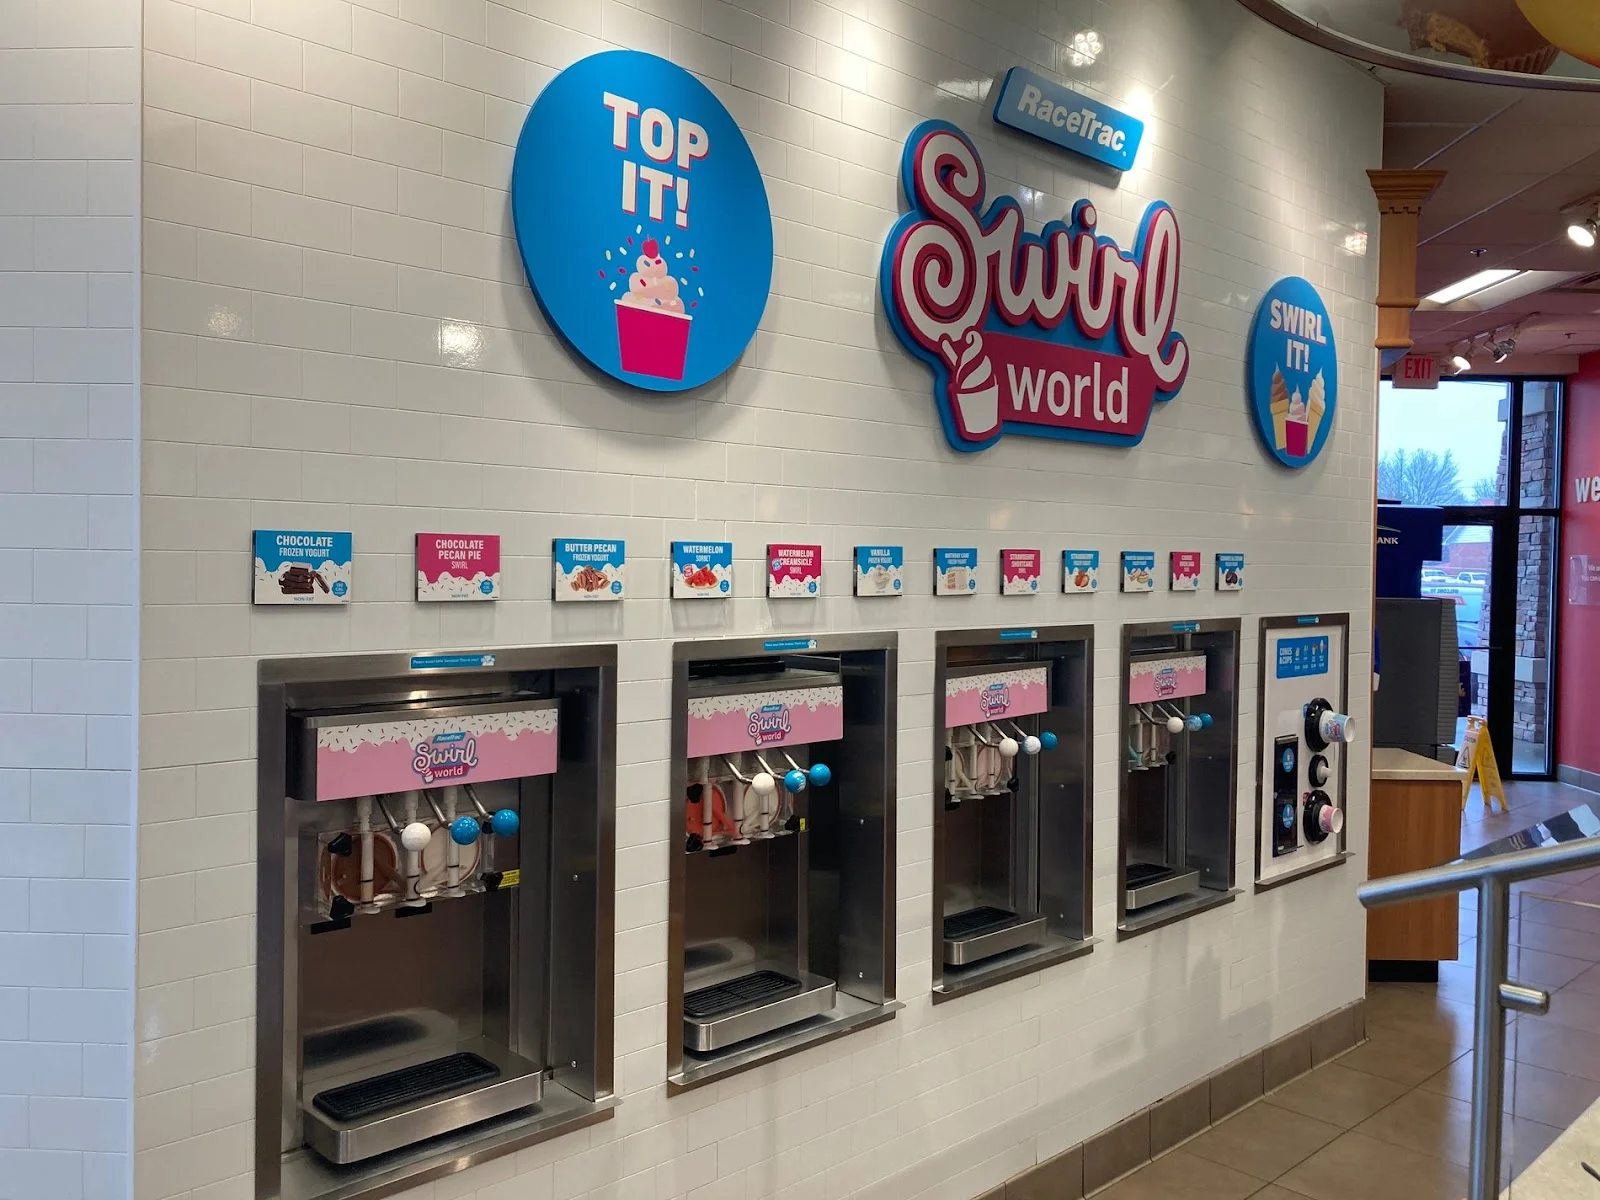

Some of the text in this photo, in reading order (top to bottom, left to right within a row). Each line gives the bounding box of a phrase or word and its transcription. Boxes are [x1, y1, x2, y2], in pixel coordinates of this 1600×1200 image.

[1017, 83, 1126, 152] RaceTrac
[603, 91, 710, 171] TOP
[621, 159, 690, 230] IT!
[896, 131, 1188, 386] Swirl
[1269, 298, 1327, 345] SWIRL
[1286, 338, 1310, 373] IT!
[1404, 357, 1434, 380] EXIT
[1006, 362, 1129, 425] world
[276, 535, 334, 547] CHOCOLATE
[435, 539, 484, 549] CHOCOLATE
[279, 547, 330, 558] FROZEN YOGURT
[565, 543, 617, 553] BUTTER PECAN
[682, 545, 724, 554] WATERMELON
[778, 549, 814, 557] WATERMELON
[438, 550, 482, 560] PECAN PIE
[572, 553, 609, 562] FROZEN YOGURT
[695, 554, 711, 562] SORBET
[451, 560, 469, 569] SWIRL
[780, 557, 813, 566] CREAMSICLE
[748, 709, 791, 736] Swirl
[762, 731, 782, 741] world
[412, 738, 478, 773] Swirl
[434, 765, 464, 778] world
